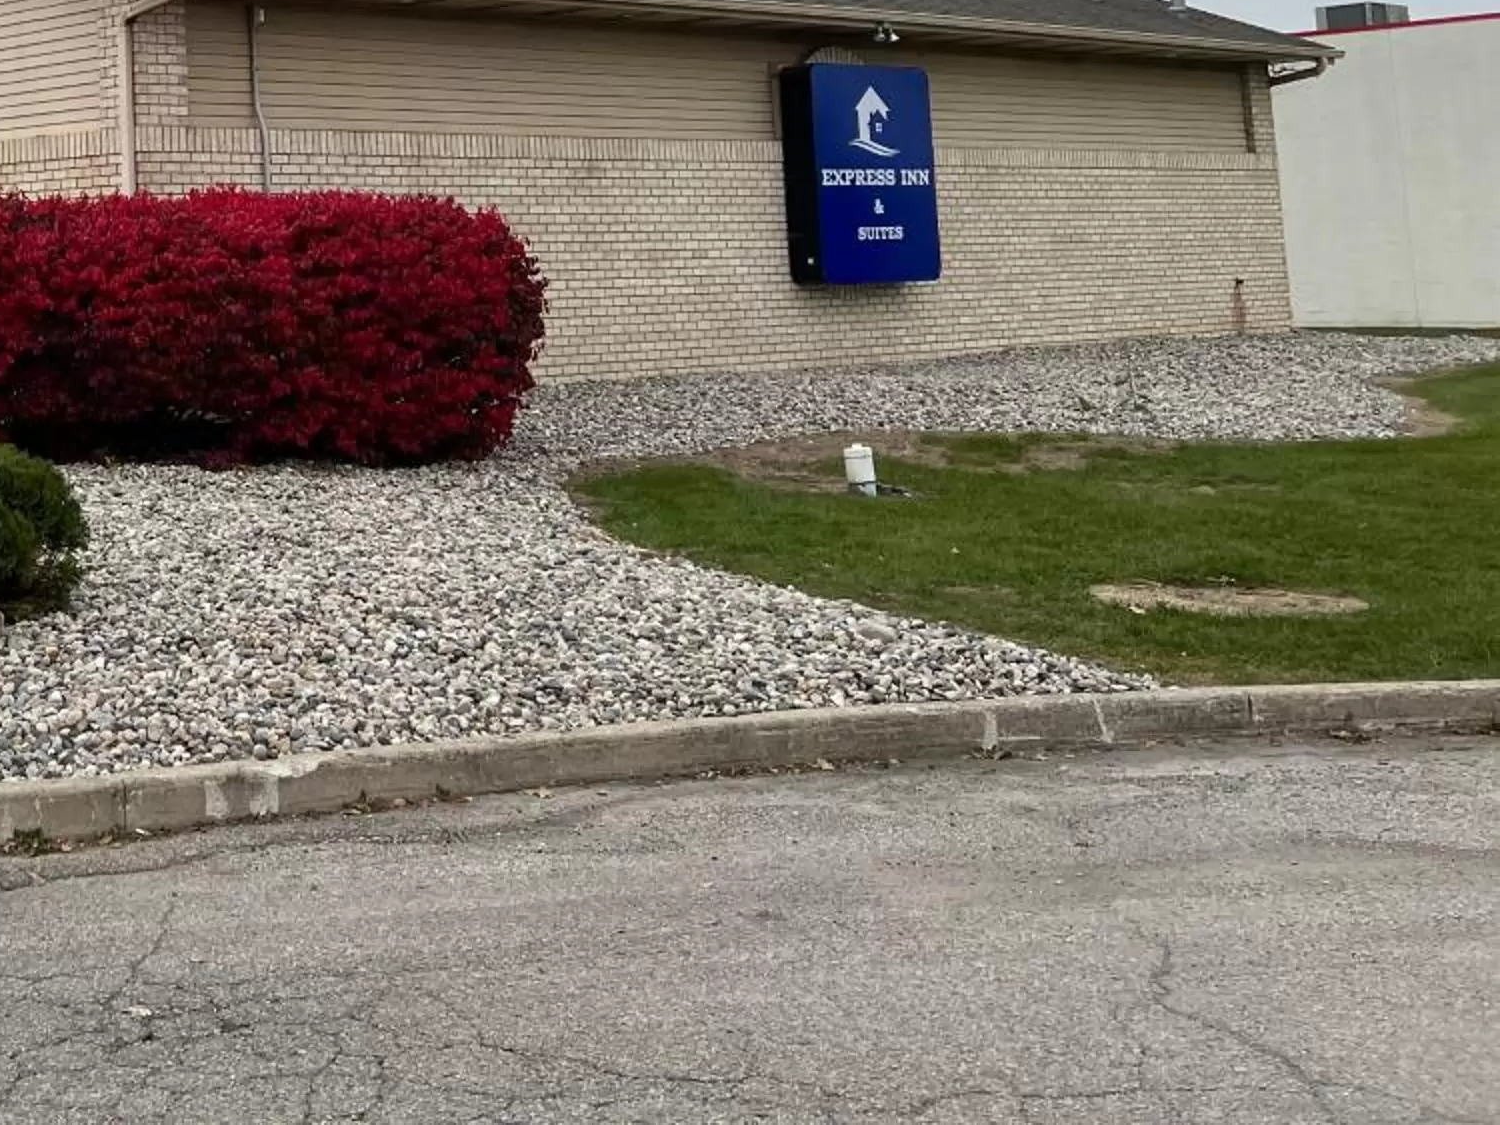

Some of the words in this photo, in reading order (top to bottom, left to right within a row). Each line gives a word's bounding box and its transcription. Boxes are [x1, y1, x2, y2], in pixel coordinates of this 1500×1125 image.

[821, 169, 896, 186] EXPRESS
[901, 169, 930, 186] INN
[873, 198, 885, 214] &
[857, 226, 904, 240] SUITES
